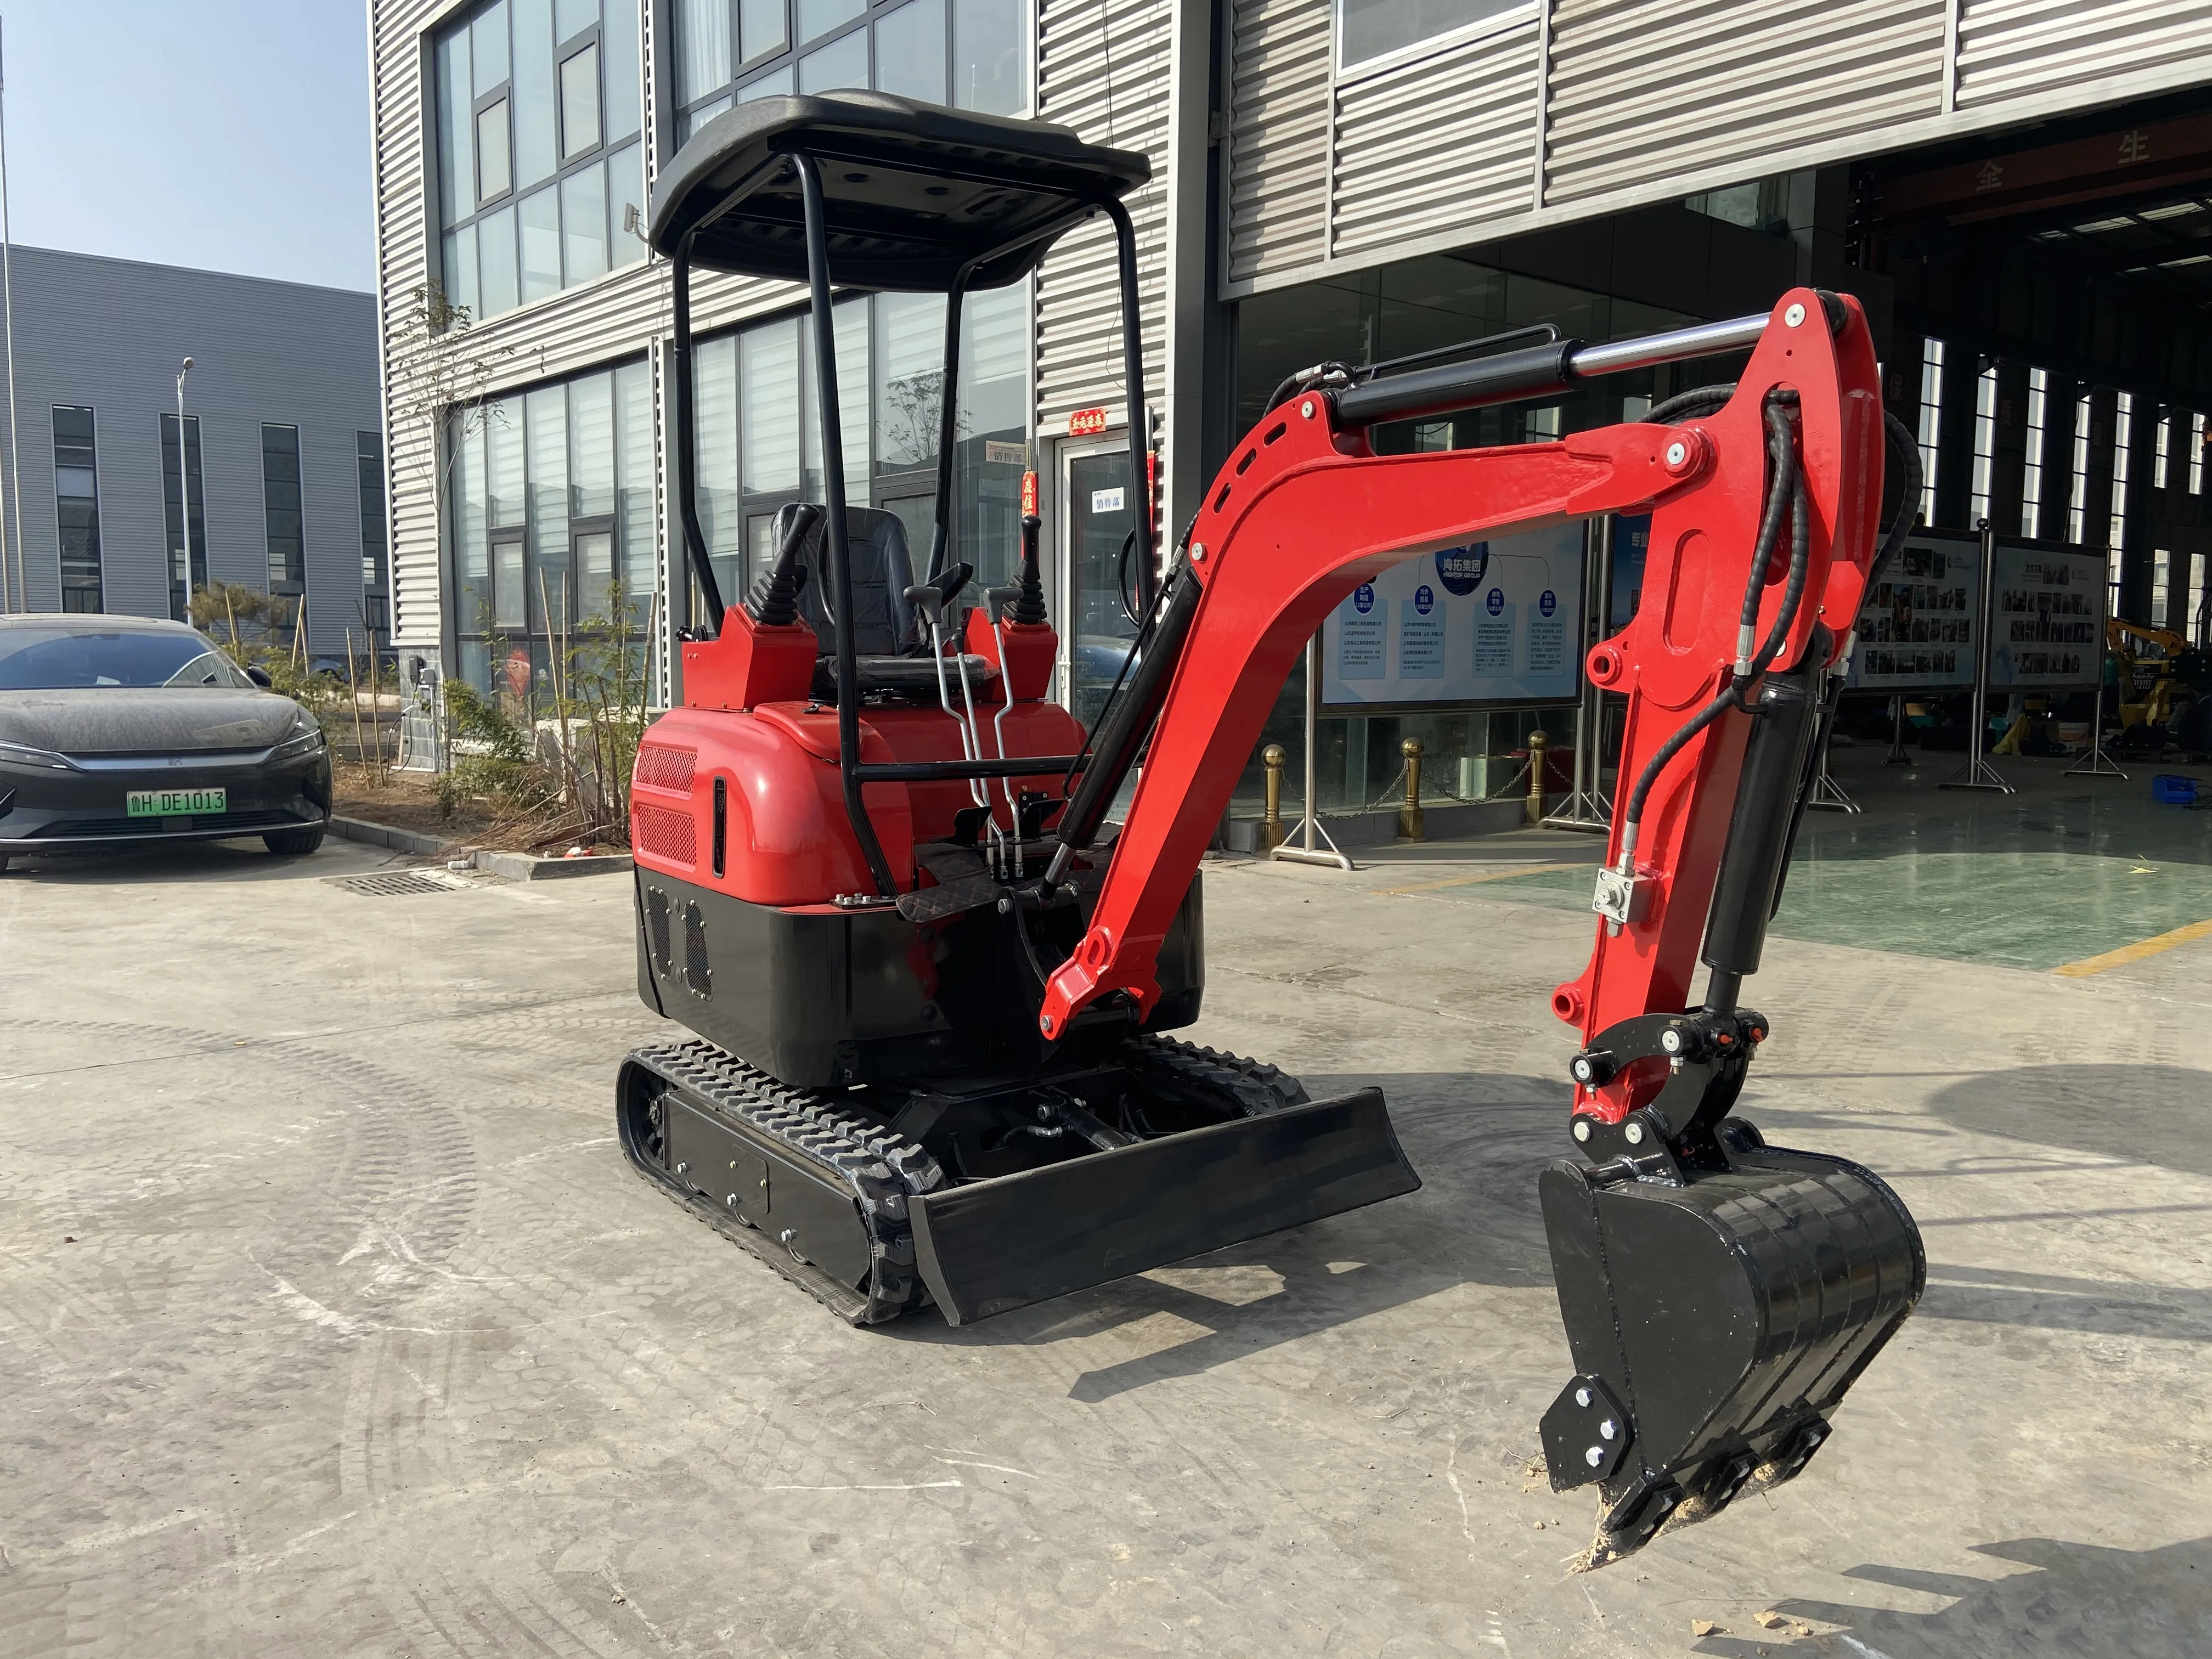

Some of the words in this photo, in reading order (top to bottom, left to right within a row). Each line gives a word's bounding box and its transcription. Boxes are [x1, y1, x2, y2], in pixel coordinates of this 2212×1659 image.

[2118, 130, 2150, 164] 生
[994, 451, 1022, 463] 销售部
[1097, 497, 1120, 509] 销售部
[1443, 558, 1481, 572] 海拓集团
[131, 794, 152, 812] 鲁H
[162, 792, 223, 811] DE1013
